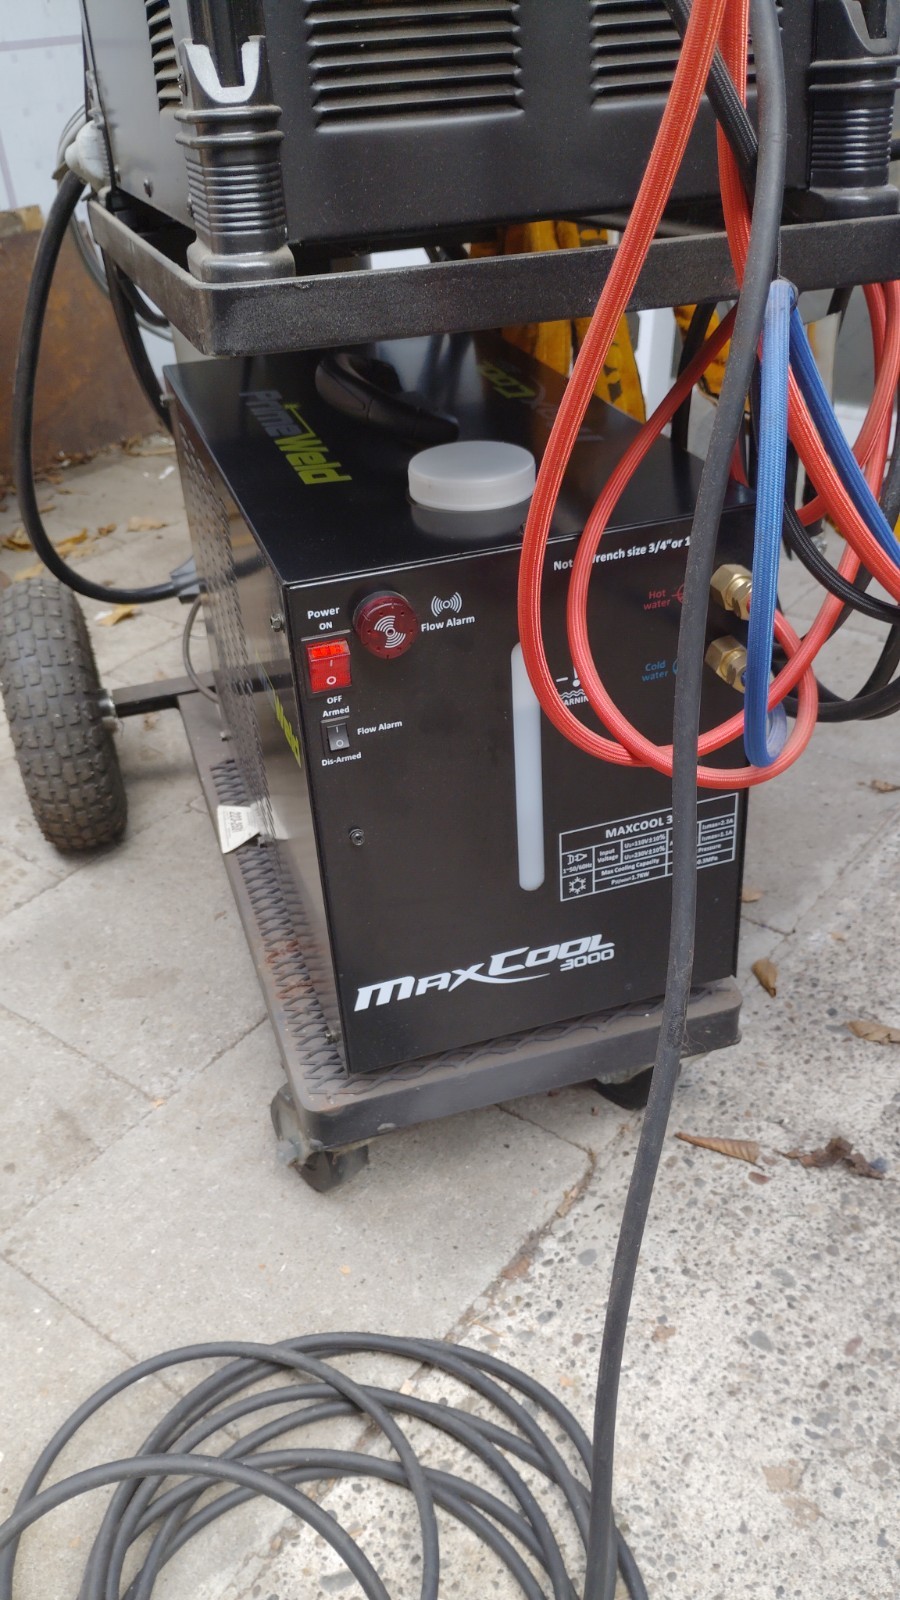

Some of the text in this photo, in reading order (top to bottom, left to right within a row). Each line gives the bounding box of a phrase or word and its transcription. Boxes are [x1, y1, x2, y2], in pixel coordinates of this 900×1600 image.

[239, 390, 352, 484] PrimeWeld
[553, 559, 573, 571] Not
[627, 545, 646, 558] size
[648, 589, 667, 600] Hot
[643, 599, 671, 611] water
[307, 606, 340, 620] Power
[319, 621, 333, 631] ON
[421, 615, 475, 632] Flow Alarm
[645, 660, 667, 672] Cold
[641, 670, 669, 682] water
[326, 695, 343, 705] OFF
[563, 695, 589, 706] ARNIN
[322, 706, 350, 718] Armed
[357, 720, 403, 735] Flow Alarm
[321, 752, 362, 767] Dis-Armed
[605, 817, 664, 839] MAXCOOL
[599, 848, 616, 859] Input
[698, 843, 722, 854] Pressure
[597, 853, 619, 864] Voltage
[601, 857, 660, 877] Max Cooling Capacity
[560, 948, 615, 972] 3000
[354, 934, 615, 1012] MAXCOOL
